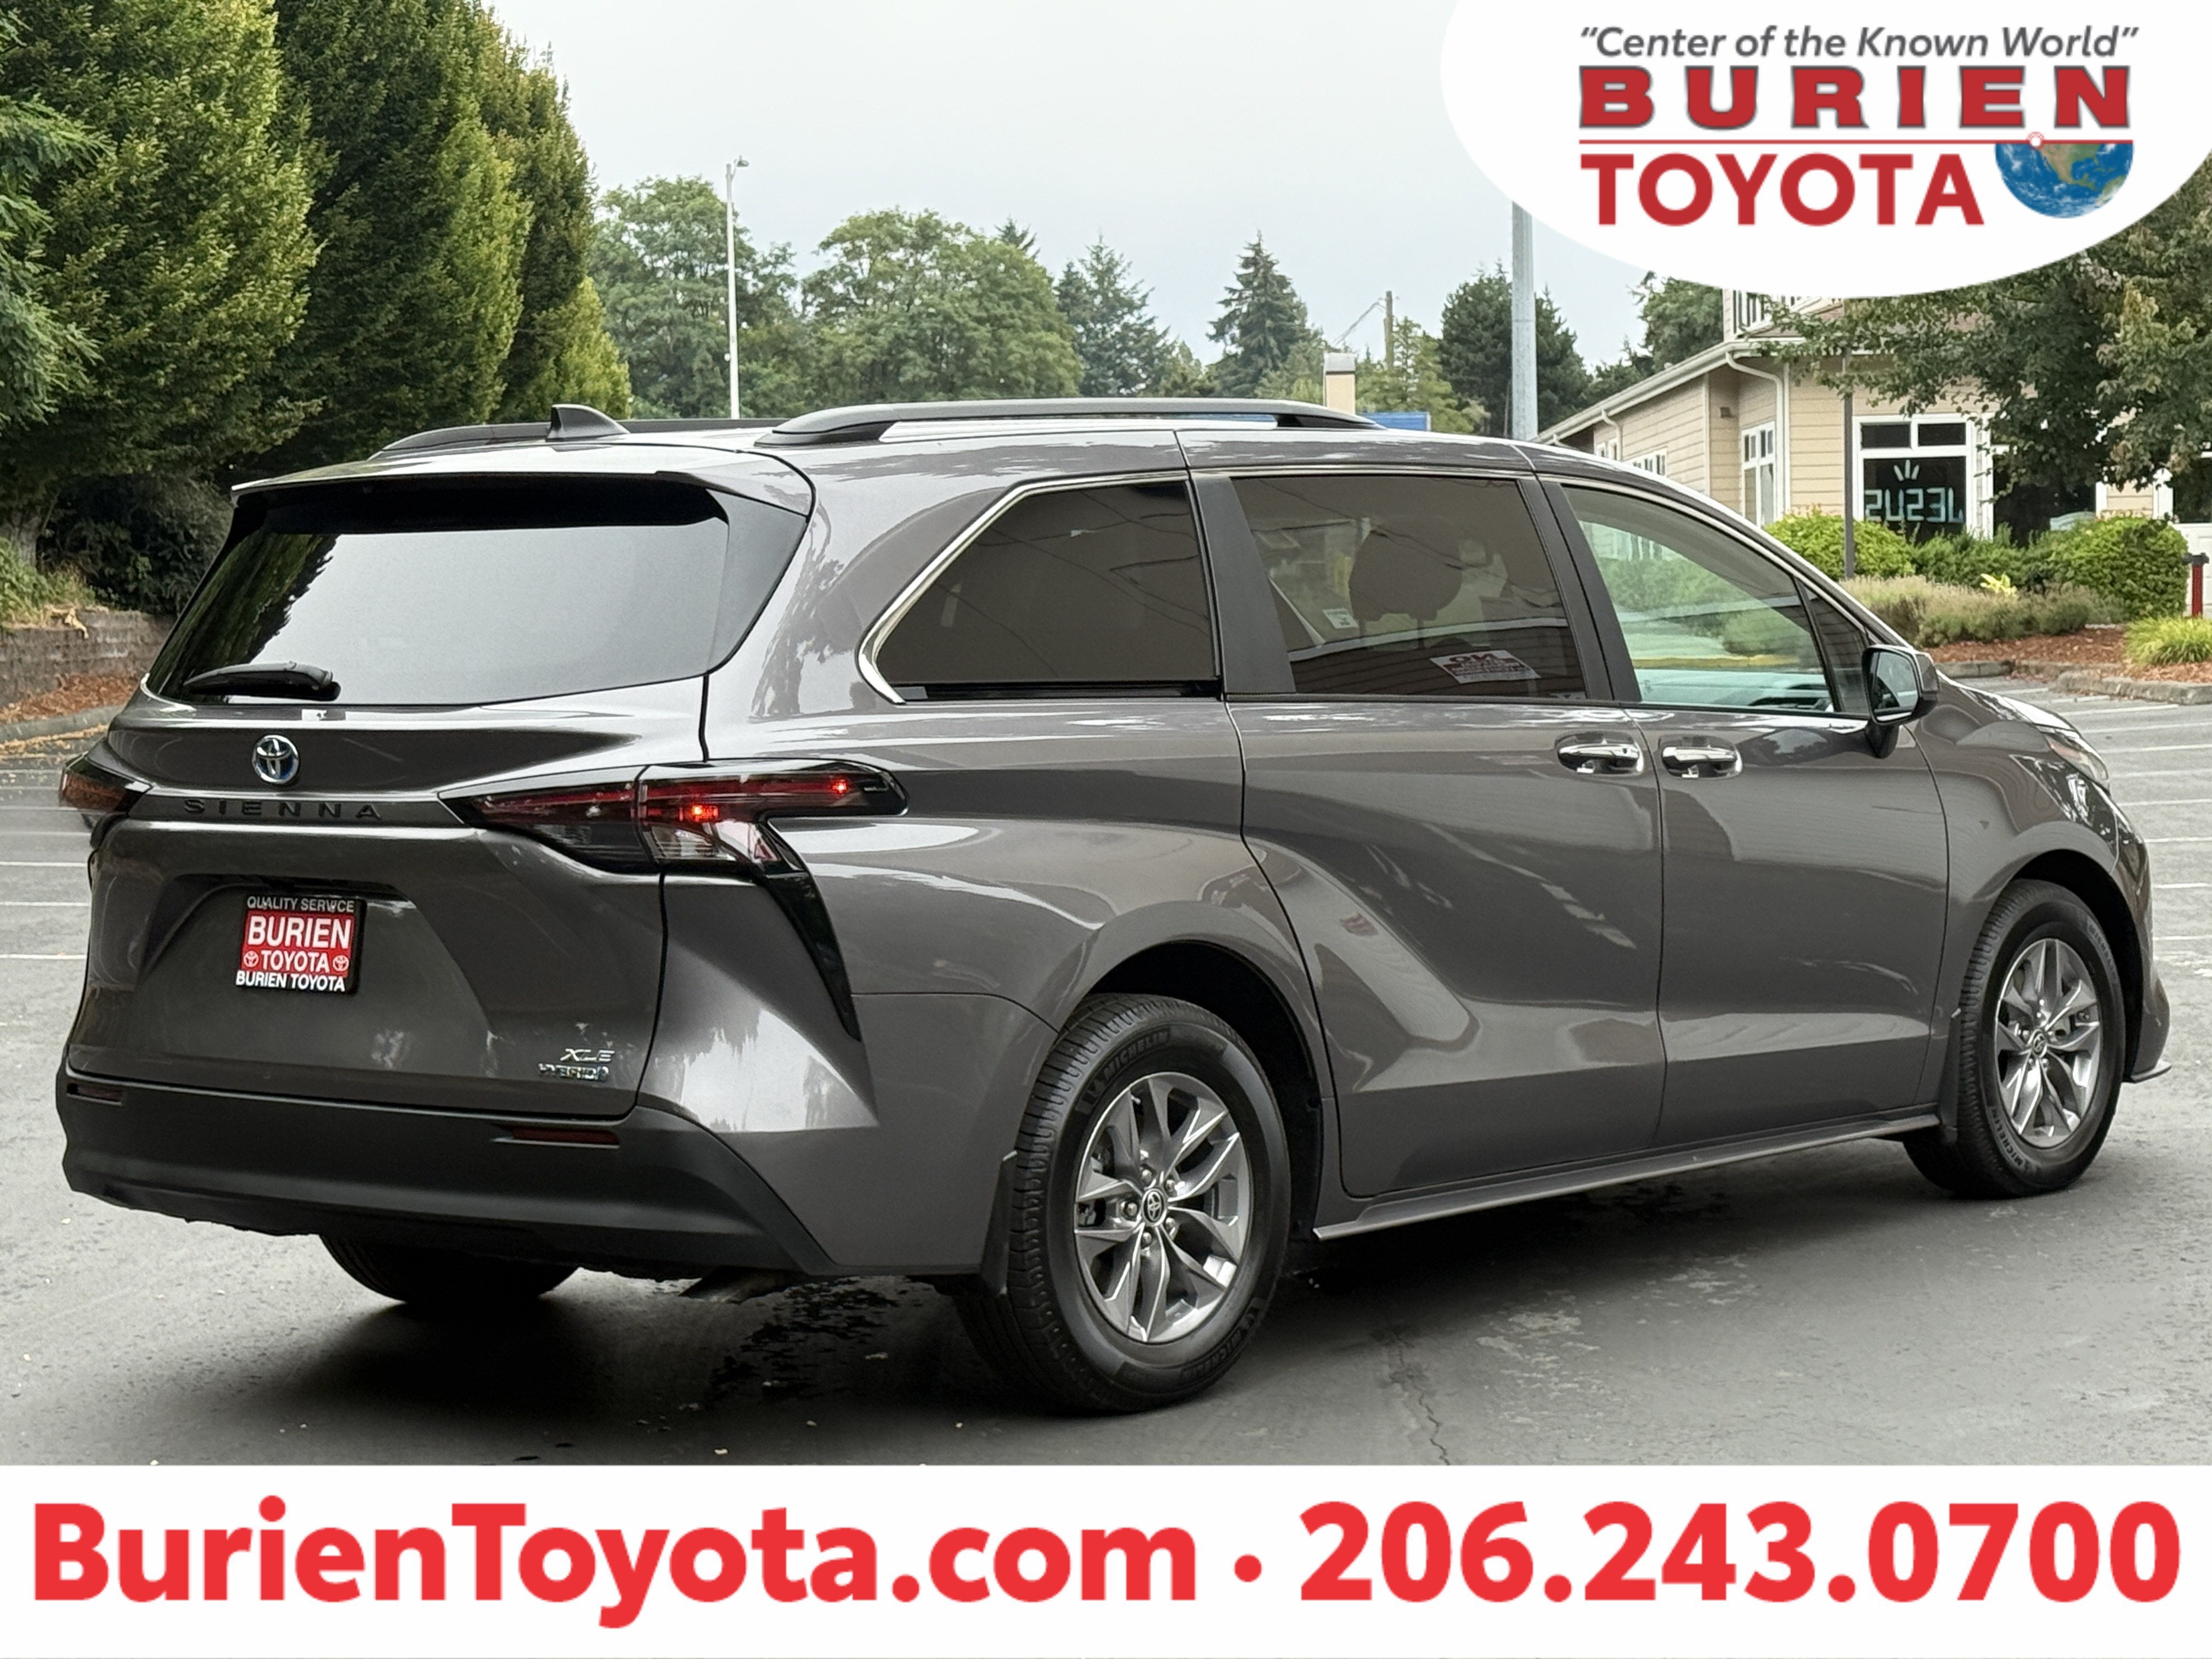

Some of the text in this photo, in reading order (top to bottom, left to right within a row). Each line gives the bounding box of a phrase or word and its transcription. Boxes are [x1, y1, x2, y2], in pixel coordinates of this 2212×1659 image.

[184, 799, 382, 820] SIENNA
[247, 896, 355, 913] QUALITY SERVICE
[247, 915, 351, 949] BURIEN
[261, 950, 330, 973] TOYOTA
[235, 970, 345, 992] BURIEN TOYOTA
[560, 1047, 616, 1062] XLE
[1103, 1028, 1171, 1080] MICHELIN
[1991, 1108, 2024, 1167] MICHELIN
